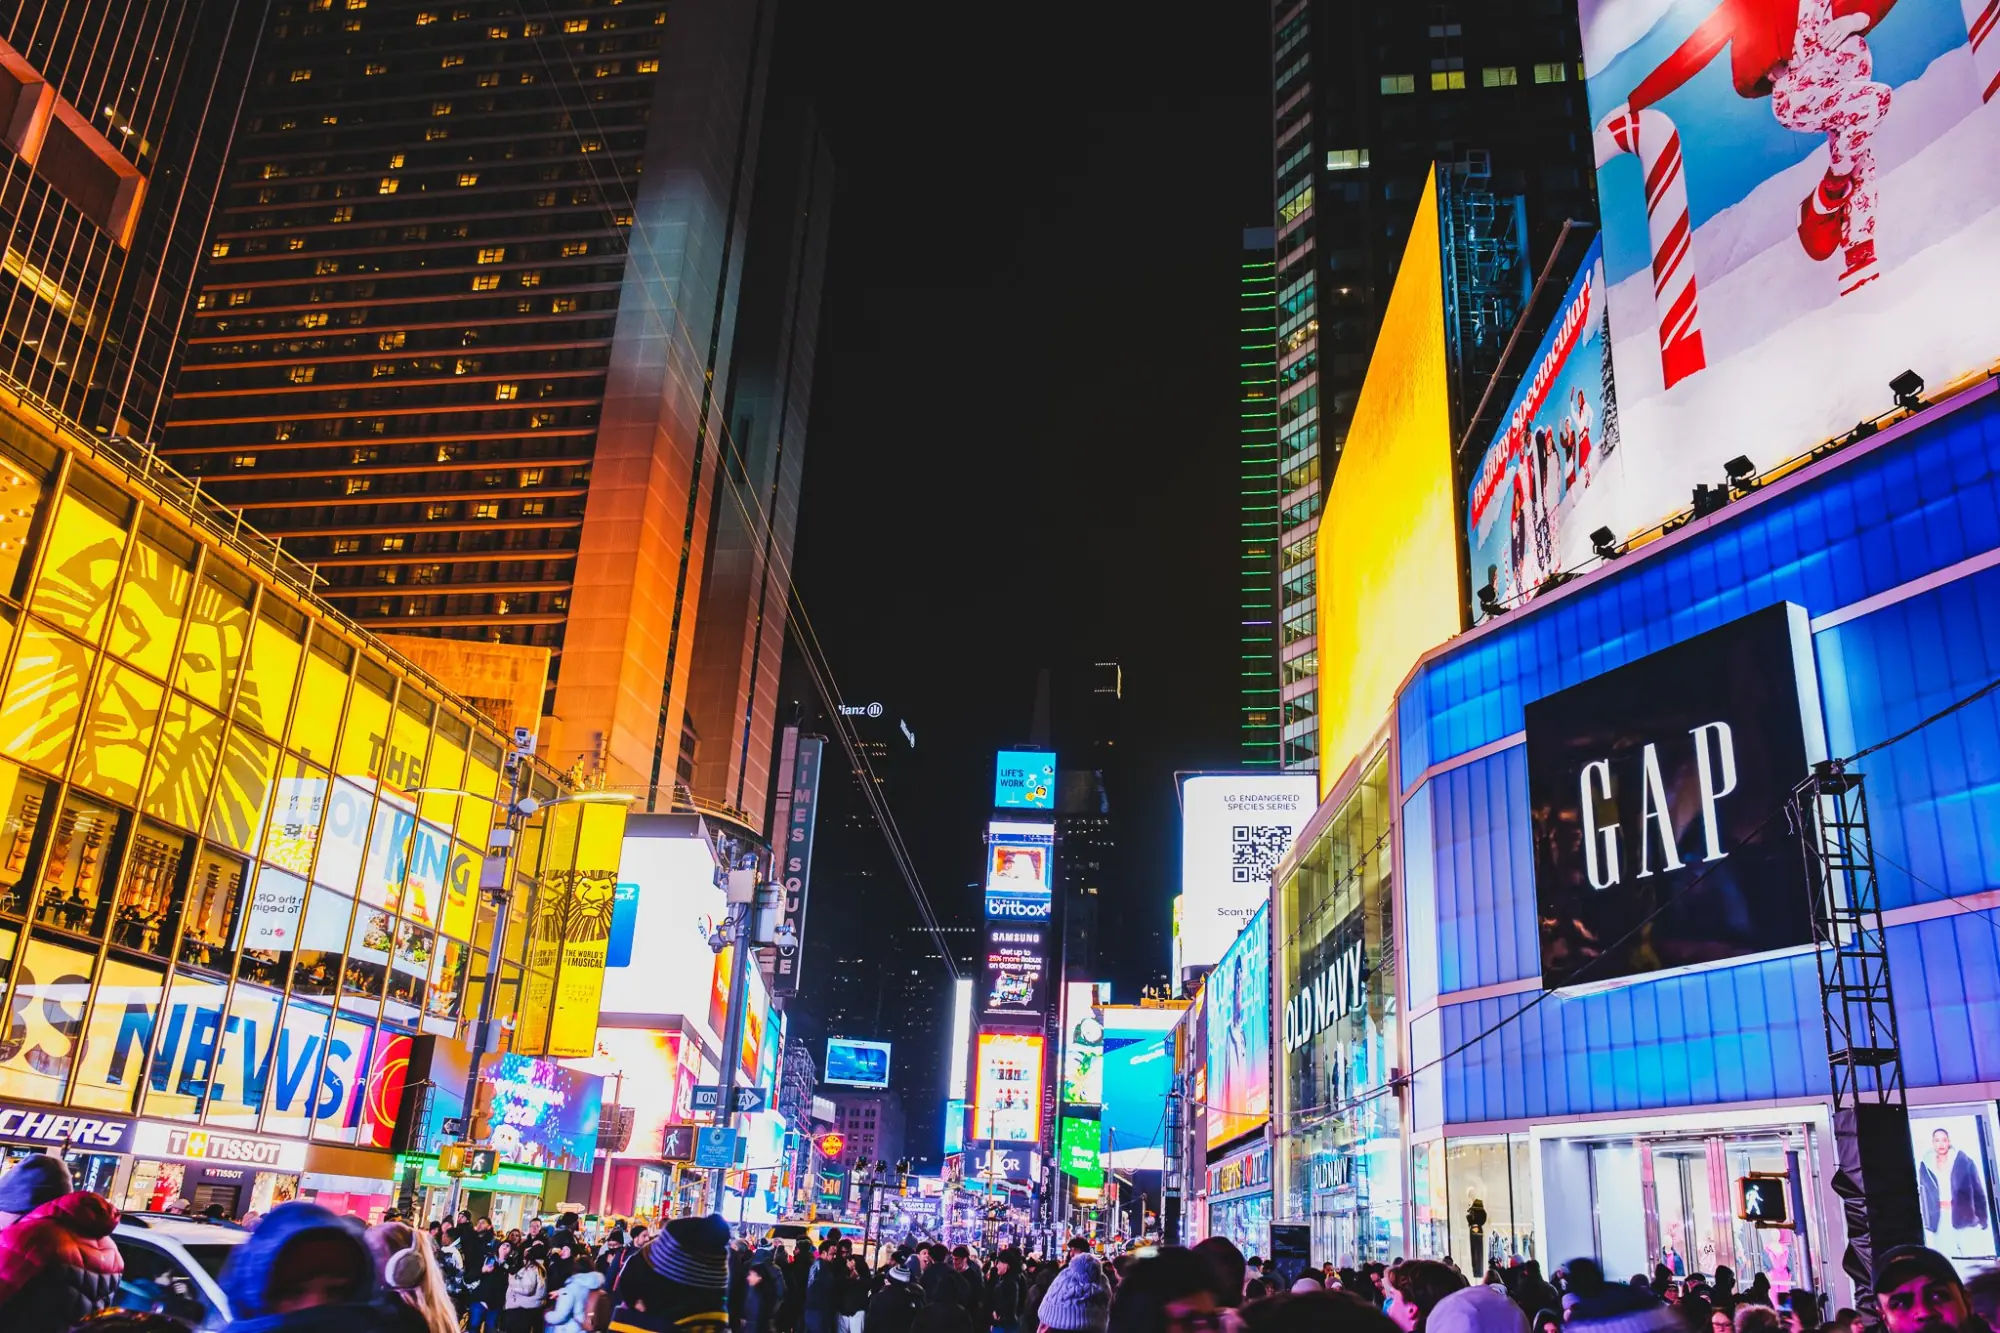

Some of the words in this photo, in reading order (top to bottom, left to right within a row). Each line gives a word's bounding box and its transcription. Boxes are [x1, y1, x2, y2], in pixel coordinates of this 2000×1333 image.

[367, 732, 422, 791] THE
[1001, 769, 1024, 778] LIFE'S
[1001, 779, 1024, 788] WORK
[792, 752, 813, 843] TIMES
[1239, 794, 1300, 803] ENDANGERED
[1227, 803, 1264, 811] SPECIES
[1267, 803, 1297, 811] SERIES
[1580, 720, 1738, 891] GAP
[384, 810, 471, 897] KING
[989, 899, 1046, 916] britbox
[1217, 907, 1244, 916] Scan
[1246, 907, 1256, 917] th
[992, 932, 1040, 943] SAMSUNG
[565, 949, 577, 957] THE
[577, 950, 604, 959] WORLD'S
[1013, 949, 1023, 958] up
[571, 957, 603, 968] MUSICAL
[999, 963, 1023, 971] Galaxy
[1285, 985, 1313, 1054] OLD
[1314, 938, 1362, 1035] NAVY
[106, 990, 353, 1120] NEWS
[702, 1093, 717, 1103] ON
[740, 1095, 755, 1105] AY
[0, 1108, 127, 1146] CHERS
[209, 1137, 281, 1164] TISSOT
[216, 1169, 243, 1179] TISSOT
[1314, 1163, 1328, 1189] OLD
[1327, 1156, 1348, 1188] NAVY
[1703, 1244, 1714, 1255] GA
